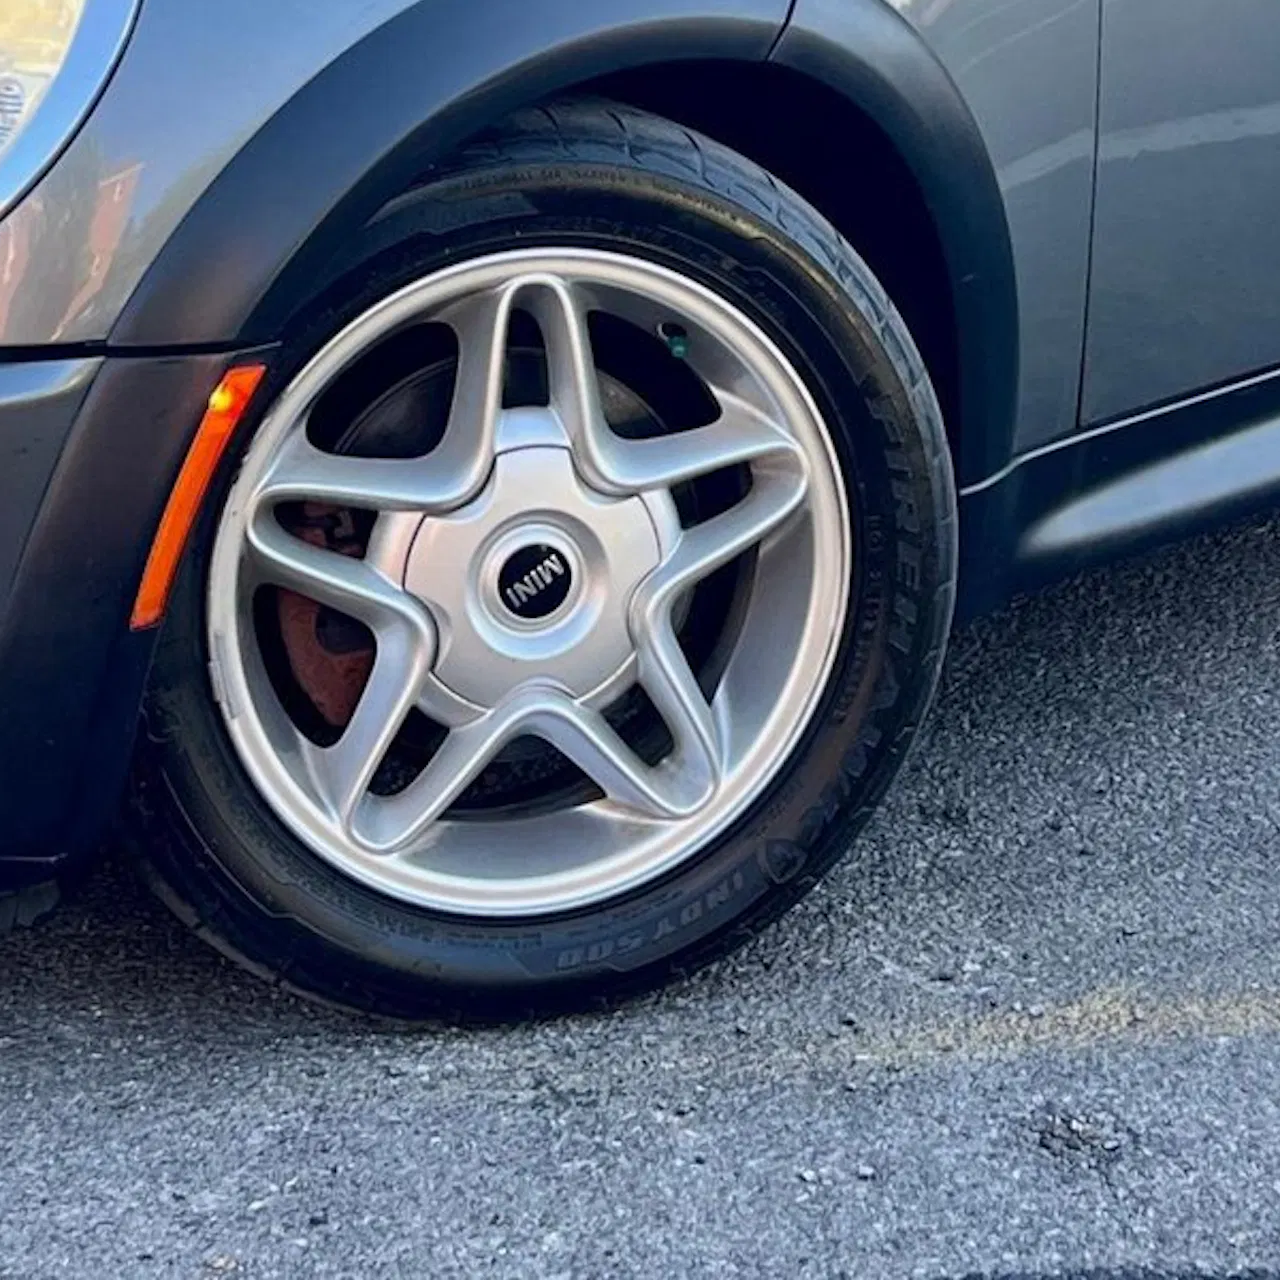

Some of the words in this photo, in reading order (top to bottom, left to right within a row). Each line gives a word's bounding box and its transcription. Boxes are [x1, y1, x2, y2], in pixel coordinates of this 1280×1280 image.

[506, 553, 565, 608] MINI
[653, 871, 745, 939] INDY
[557, 932, 645, 969] 500
